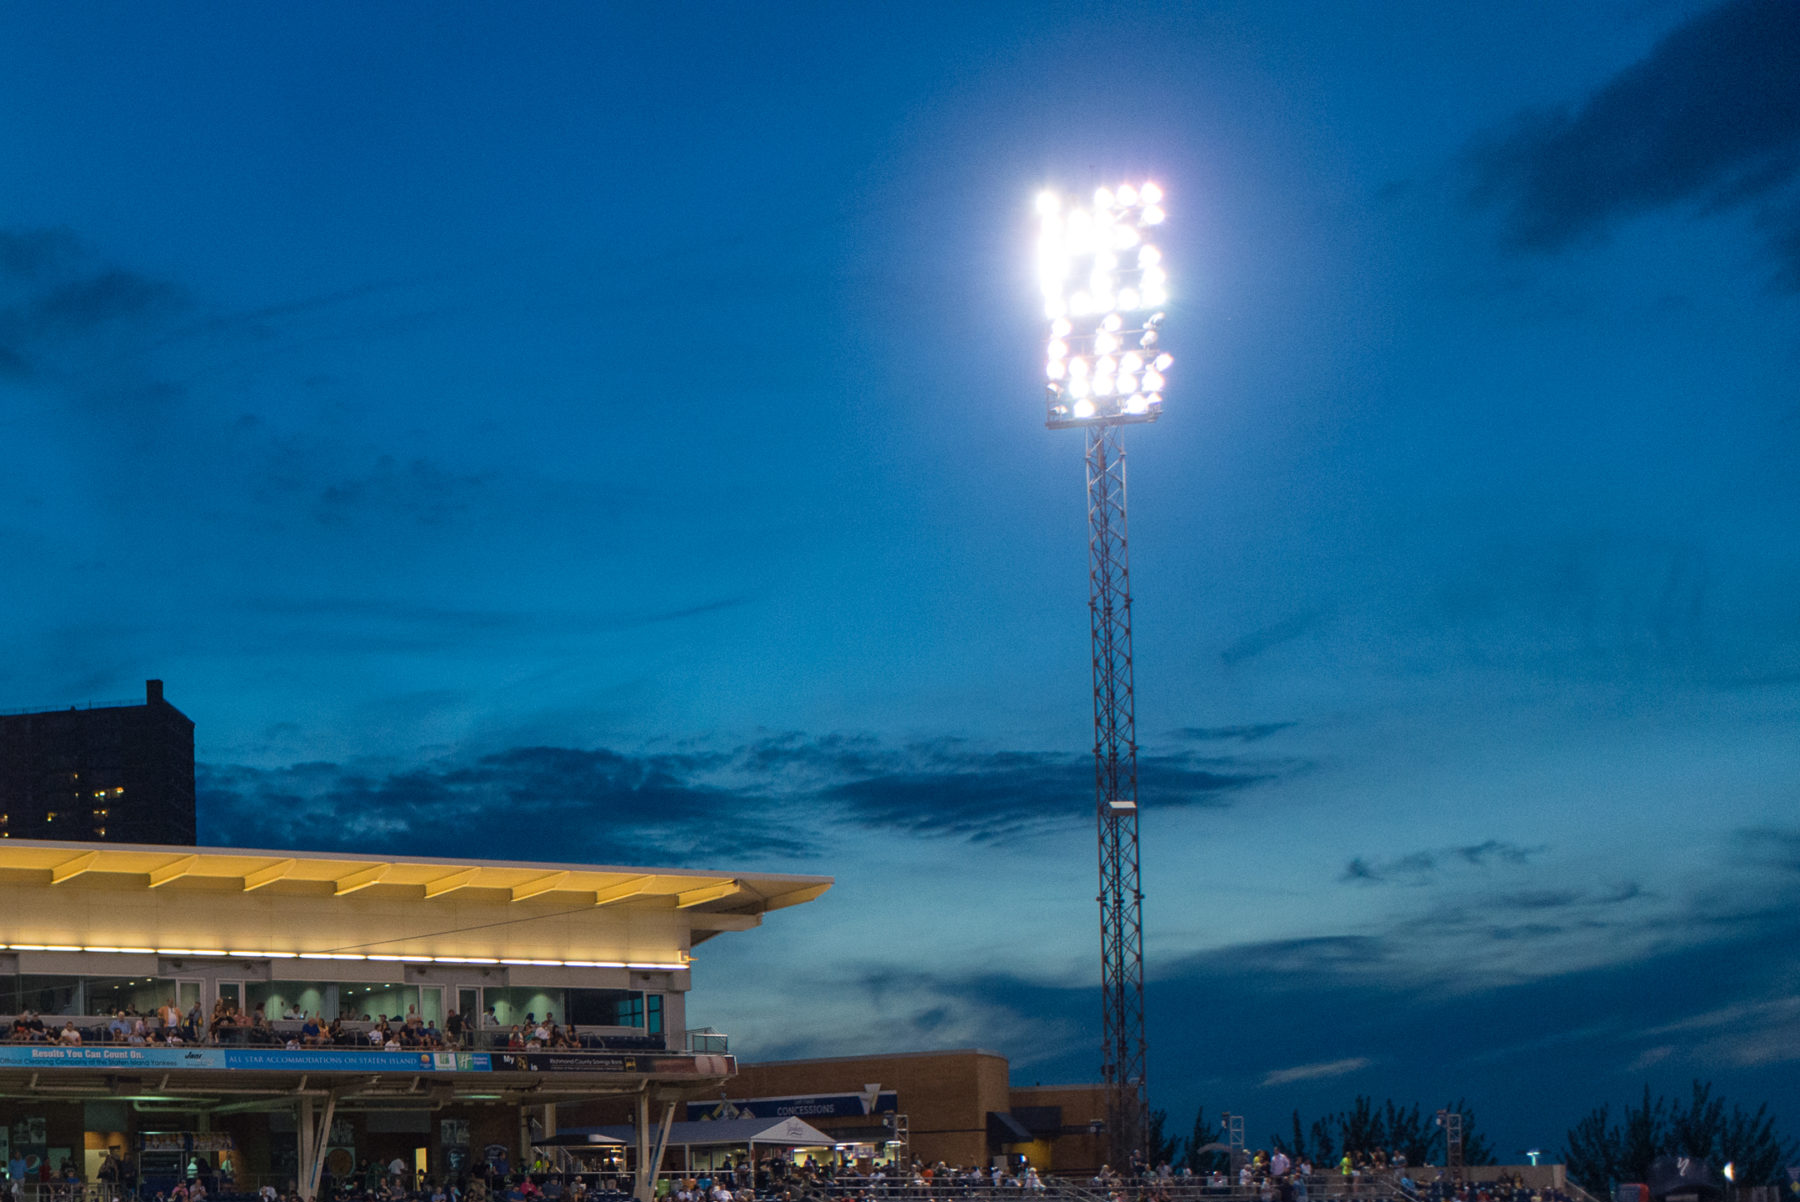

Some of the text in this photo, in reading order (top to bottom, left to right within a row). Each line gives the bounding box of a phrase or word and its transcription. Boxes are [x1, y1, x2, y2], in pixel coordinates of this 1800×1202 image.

[32, 1049, 64, 1058] Results
[66, 1050, 82, 1058] You
[85, 1050, 102, 1058] Can
[104, 1050, 128, 1059] Count
[24, 1058, 54, 1067] Cleaning
[108, 1058, 131, 1066] Staten
[151, 1059, 177, 1067] Yankees
[245, 1056, 264, 1064] STAR
[266, 1056, 342, 1064] ACCOMMODATIONS
[344, 1056, 357, 1064] ON
[358, 1056, 387, 1064] STATEN
[389, 1057, 417, 1065] ISLAND
[503, 1055, 515, 1064] My
[777, 1104, 835, 1116] CONCESSIONS
